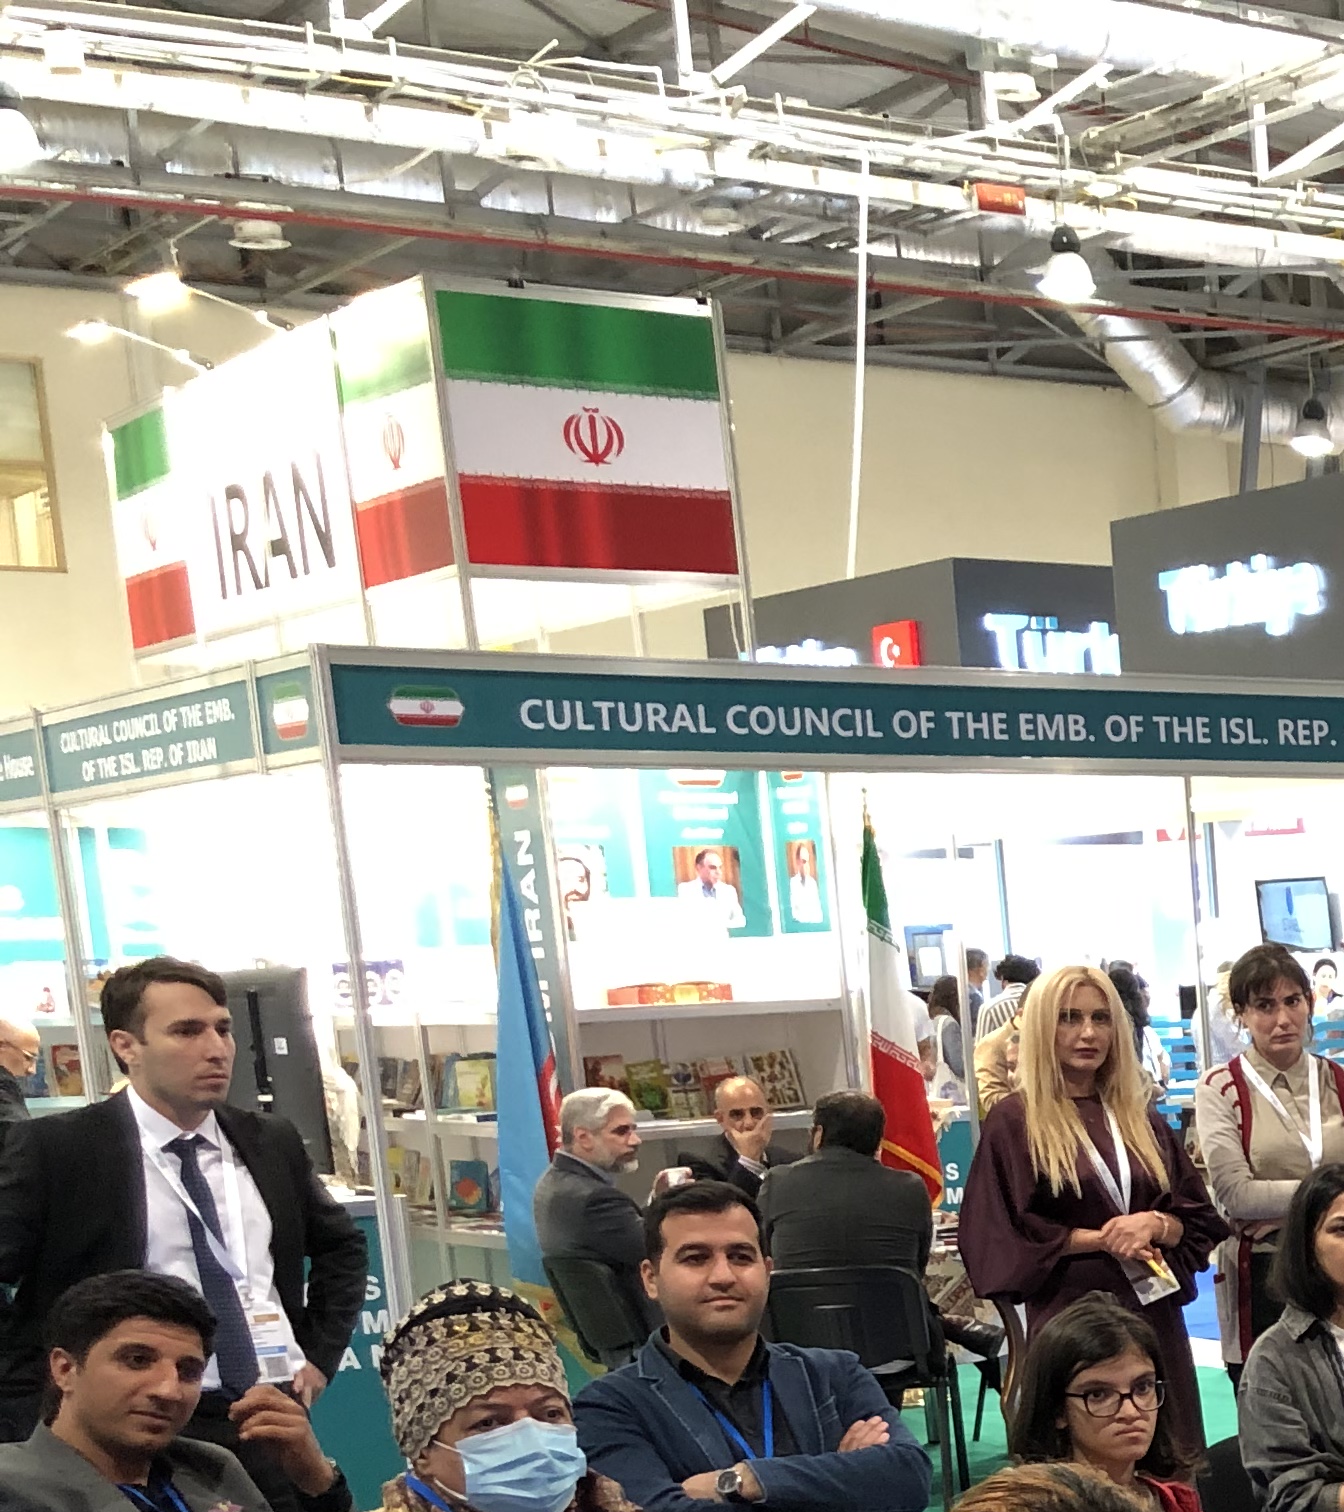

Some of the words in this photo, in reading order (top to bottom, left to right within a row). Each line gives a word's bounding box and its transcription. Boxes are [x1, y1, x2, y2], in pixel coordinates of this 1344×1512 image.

[209, 450, 338, 600] IRAN
[60, 724, 112, 754] CULTURAL
[113, 714, 162, 742] COUNCIL
[163, 709, 178, 732] OF
[179, 704, 202, 729] THE
[520, 698, 716, 735] CULTURAL
[726, 704, 883, 739] COUNCIL
[892, 709, 936, 739] OF
[945, 711, 1009, 741] THE
[1020, 713, 1095, 742] EMB.
[1105, 715, 1144, 744] OF
[1152, 716, 1210, 745] THE
[1220, 717, 1268, 746] ISL.
[1278, 719, 1337, 747] REP.
[82, 760, 97, 781] OF
[98, 755, 118, 777] THE
[169, 744, 183, 767] OF
[186, 738, 217, 763] IRAN
